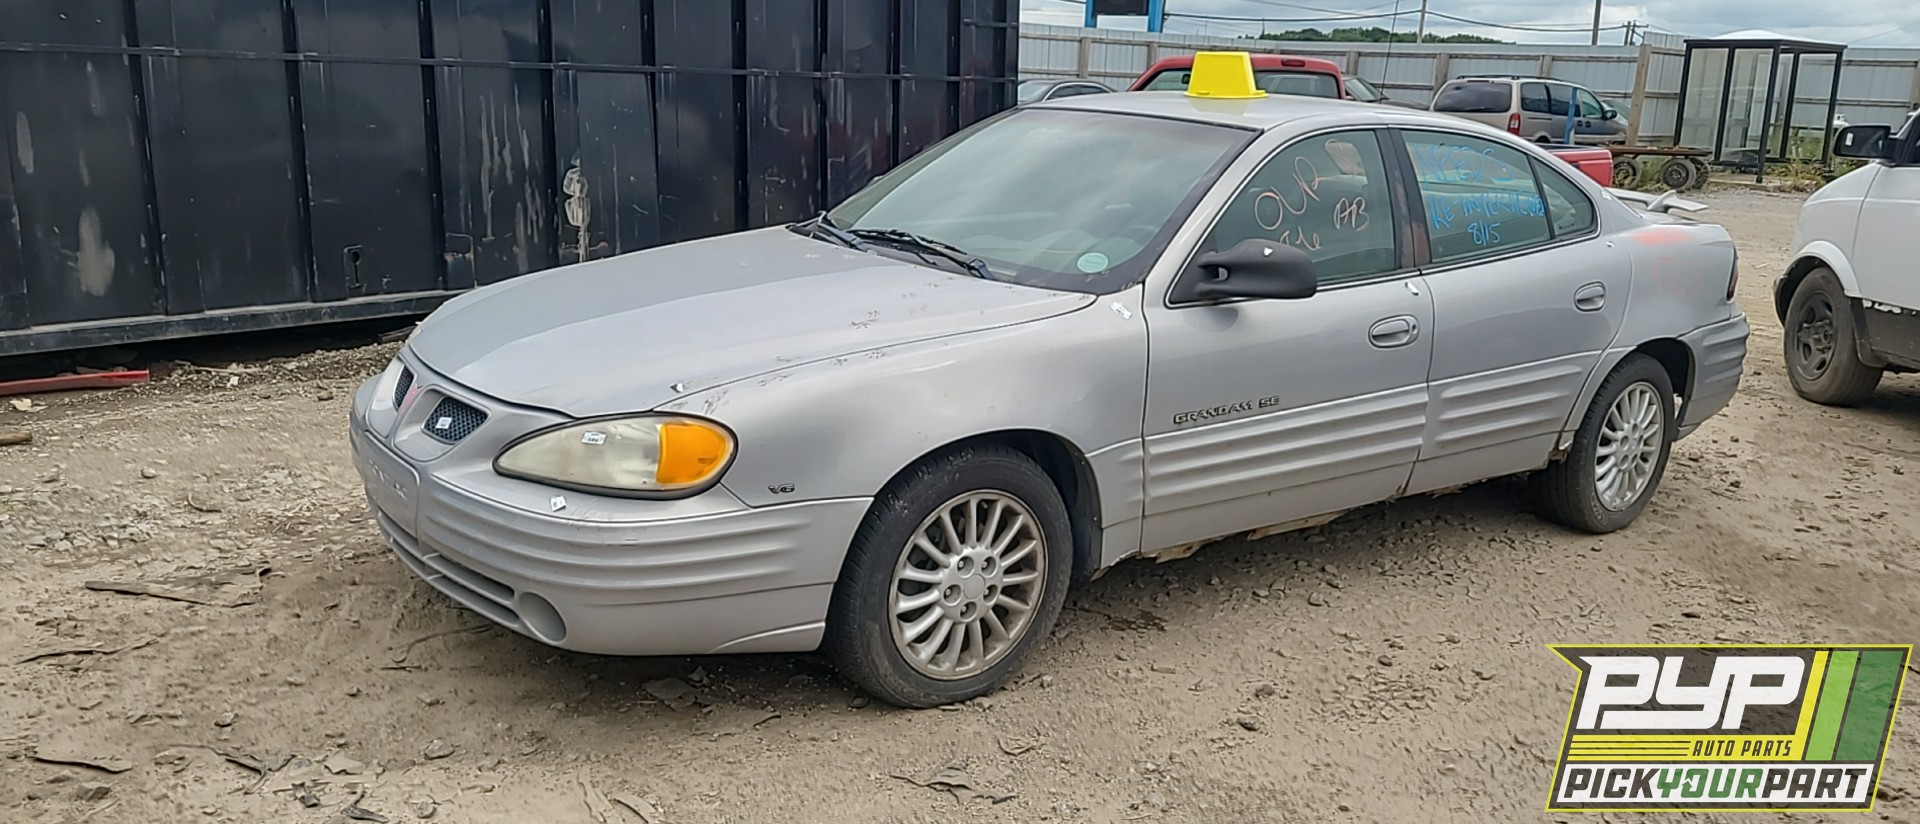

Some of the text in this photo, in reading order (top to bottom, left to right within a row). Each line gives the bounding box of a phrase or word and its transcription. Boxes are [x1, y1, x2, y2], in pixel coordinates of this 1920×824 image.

[1467, 220, 1501, 246] 8/15
[1258, 396, 1280, 408] SE
[767, 483, 795, 494] V6
